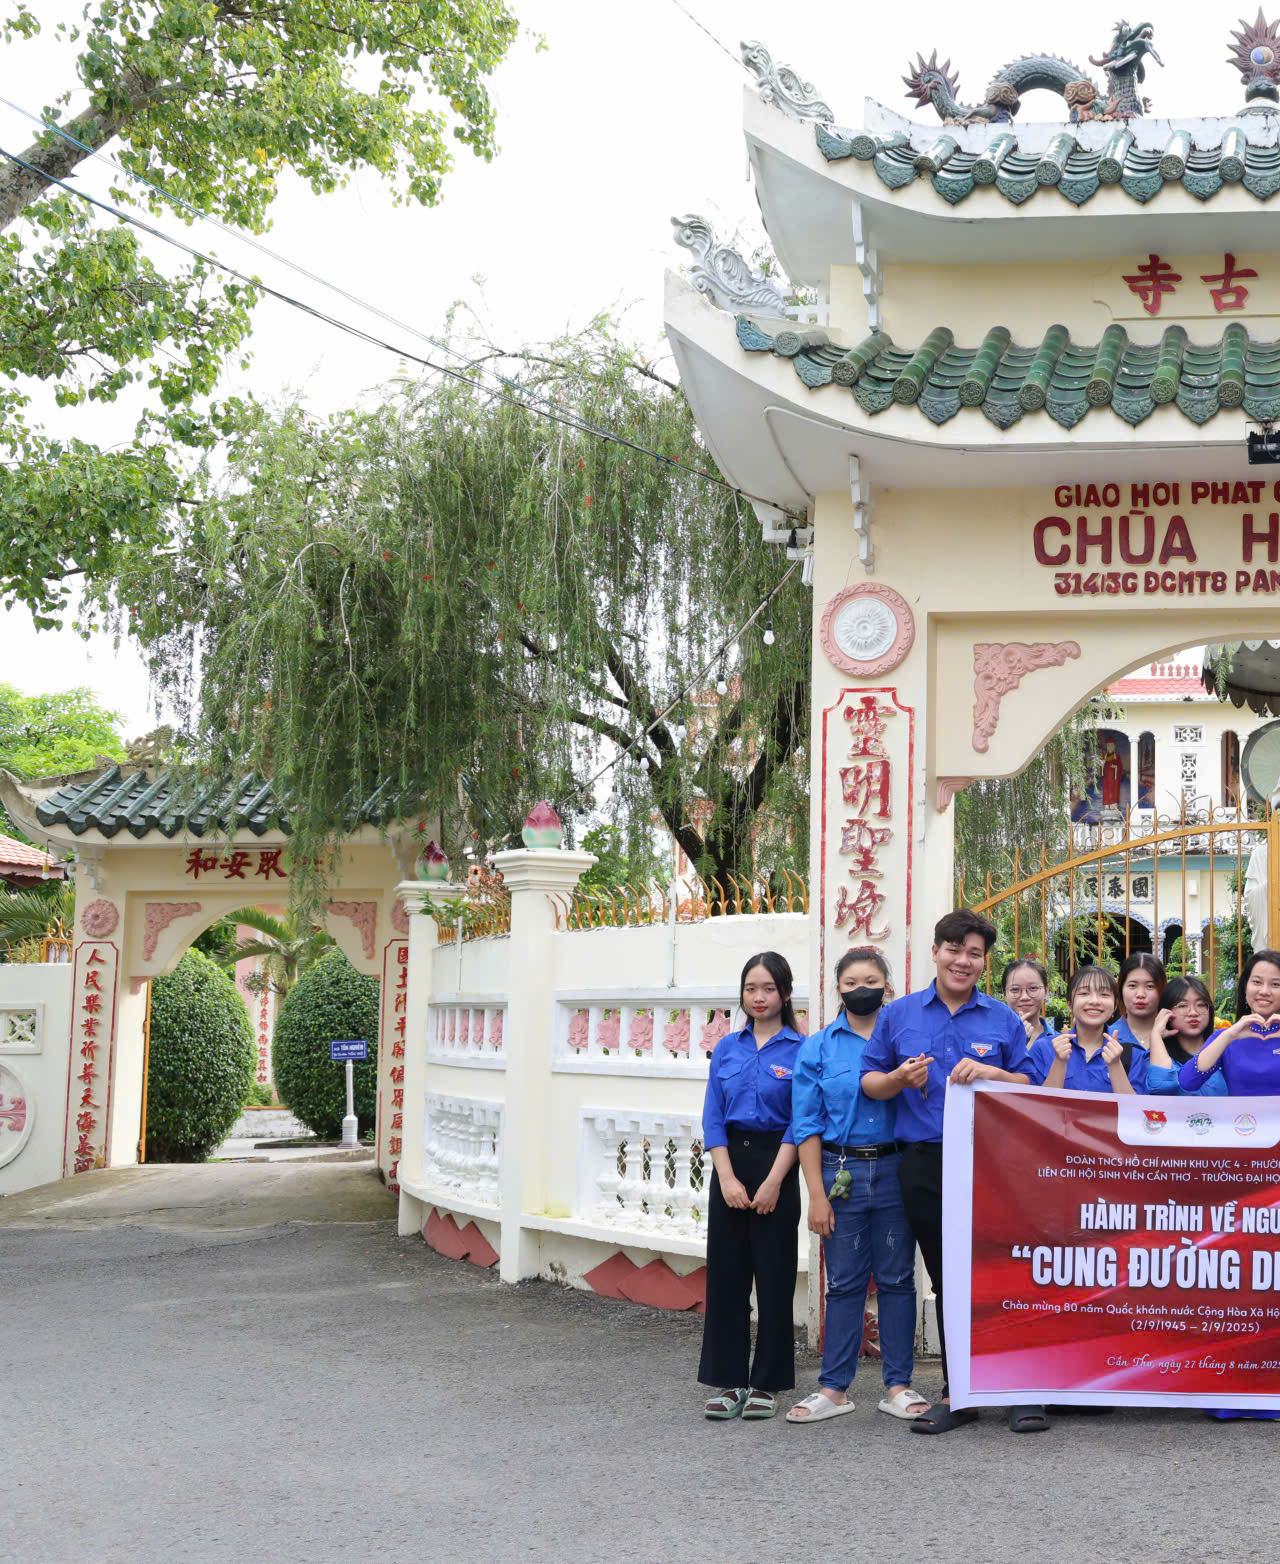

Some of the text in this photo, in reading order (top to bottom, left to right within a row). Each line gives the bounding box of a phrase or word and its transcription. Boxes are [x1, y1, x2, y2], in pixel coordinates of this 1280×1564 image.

[1054, 483, 1120, 508] GIAO
[1131, 482, 1180, 507] HOI
[1191, 481, 1266, 505] PHAT
[1033, 509, 1197, 566] CHÙA
[833, 695, 898, 953] 靈明聖境
[1066, 1154, 1096, 1165] ĐOÀN
[1098, 1157, 1123, 1167] TNCS
[1125, 1153, 1140, 1167] HỒ
[1142, 1156, 1159, 1168] CHÍ
[1161, 1159, 1187, 1168] MINH
[1189, 1159, 1209, 1169] KHU
[1211, 1158, 1232, 1171] VỰC
[1234, 1160, 1241, 1169] 4
[1038, 1166, 1058, 1178] LIÊN
[1060, 1168, 1076, 1178] CHI
[1078, 1169, 1097, 1180] HỘI
[1099, 1170, 1121, 1180] SINH
[1123, 1169, 1145, 1180] VIÊN
[1170, 1172, 1191, 1182] THƠ
[1202, 1172, 1244, 1183] TRƯỜNG
[1246, 1174, 1263, 1185] ĐẠI
[1080, 1196, 1137, 1231] HÀNH
[1143, 1198, 1204, 1232] TRÌNH
[1210, 1200, 1239, 1233] VỀ
[1128, 1236, 1242, 1290] ĐƯỜNG
[1002, 1300, 1030, 1310] Chào
[1032, 1302, 1061, 1314] mừng
[1063, 1302, 1078, 1312] 80
[1080, 1303, 1104, 1313] năm
[1106, 1302, 1133, 1314] Quốc
[1136, 1303, 1168, 1315] khánh
[1170, 1305, 1195, 1316] nước
[1197, 1305, 1224, 1319] Cộng
[1227, 1306, 1248, 1317] Hòa
[1250, 1307, 1264, 1317] Xã
[1130, 1319, 1187, 1332] (2/9/1945
[1201, 1321, 1260, 1334] 2/9/2025)
[1106, 1355, 1128, 1367] Cần
[1158, 1359, 1182, 1374] ngày
[1184, 1360, 1196, 1369] 27
[1198, 1355, 1226, 1375] tháng
[1229, 1360, 1235, 1369] 8
[1237, 1360, 1259, 1369] năm
